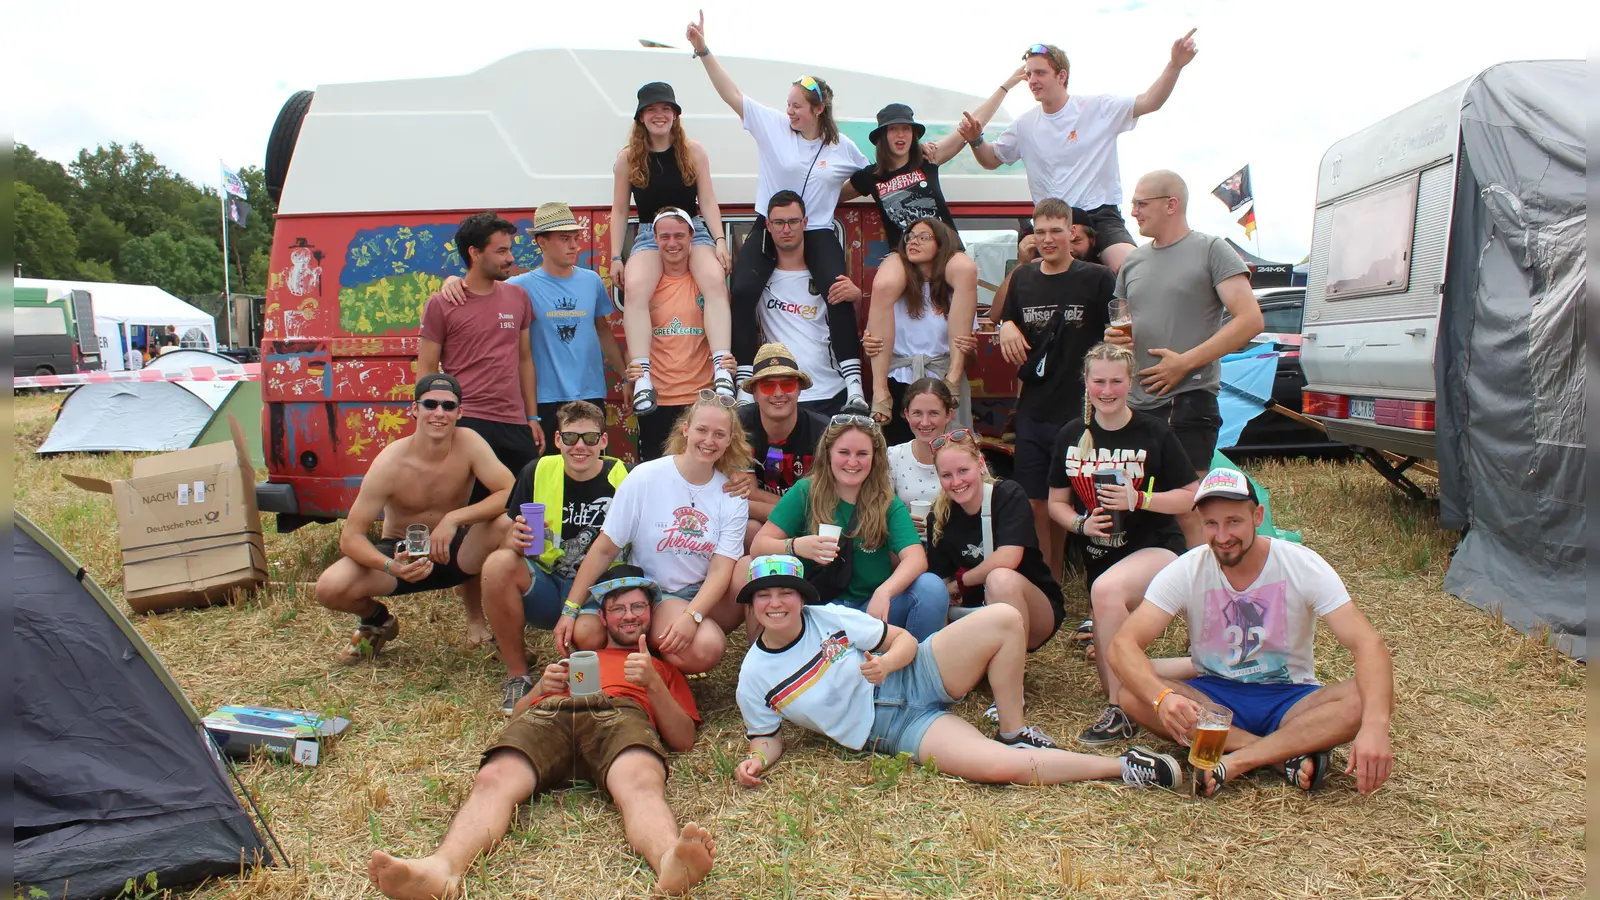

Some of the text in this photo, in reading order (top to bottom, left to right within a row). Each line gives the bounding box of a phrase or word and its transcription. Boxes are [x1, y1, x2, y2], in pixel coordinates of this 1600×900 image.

[876, 170, 922, 190] TAUBERTAL
[887, 176, 926, 192] FESTIVAL
[767, 299, 818, 316] CHECK24
[146, 518, 203, 534] Deutsche Post
[1224, 625, 1267, 667] 32
